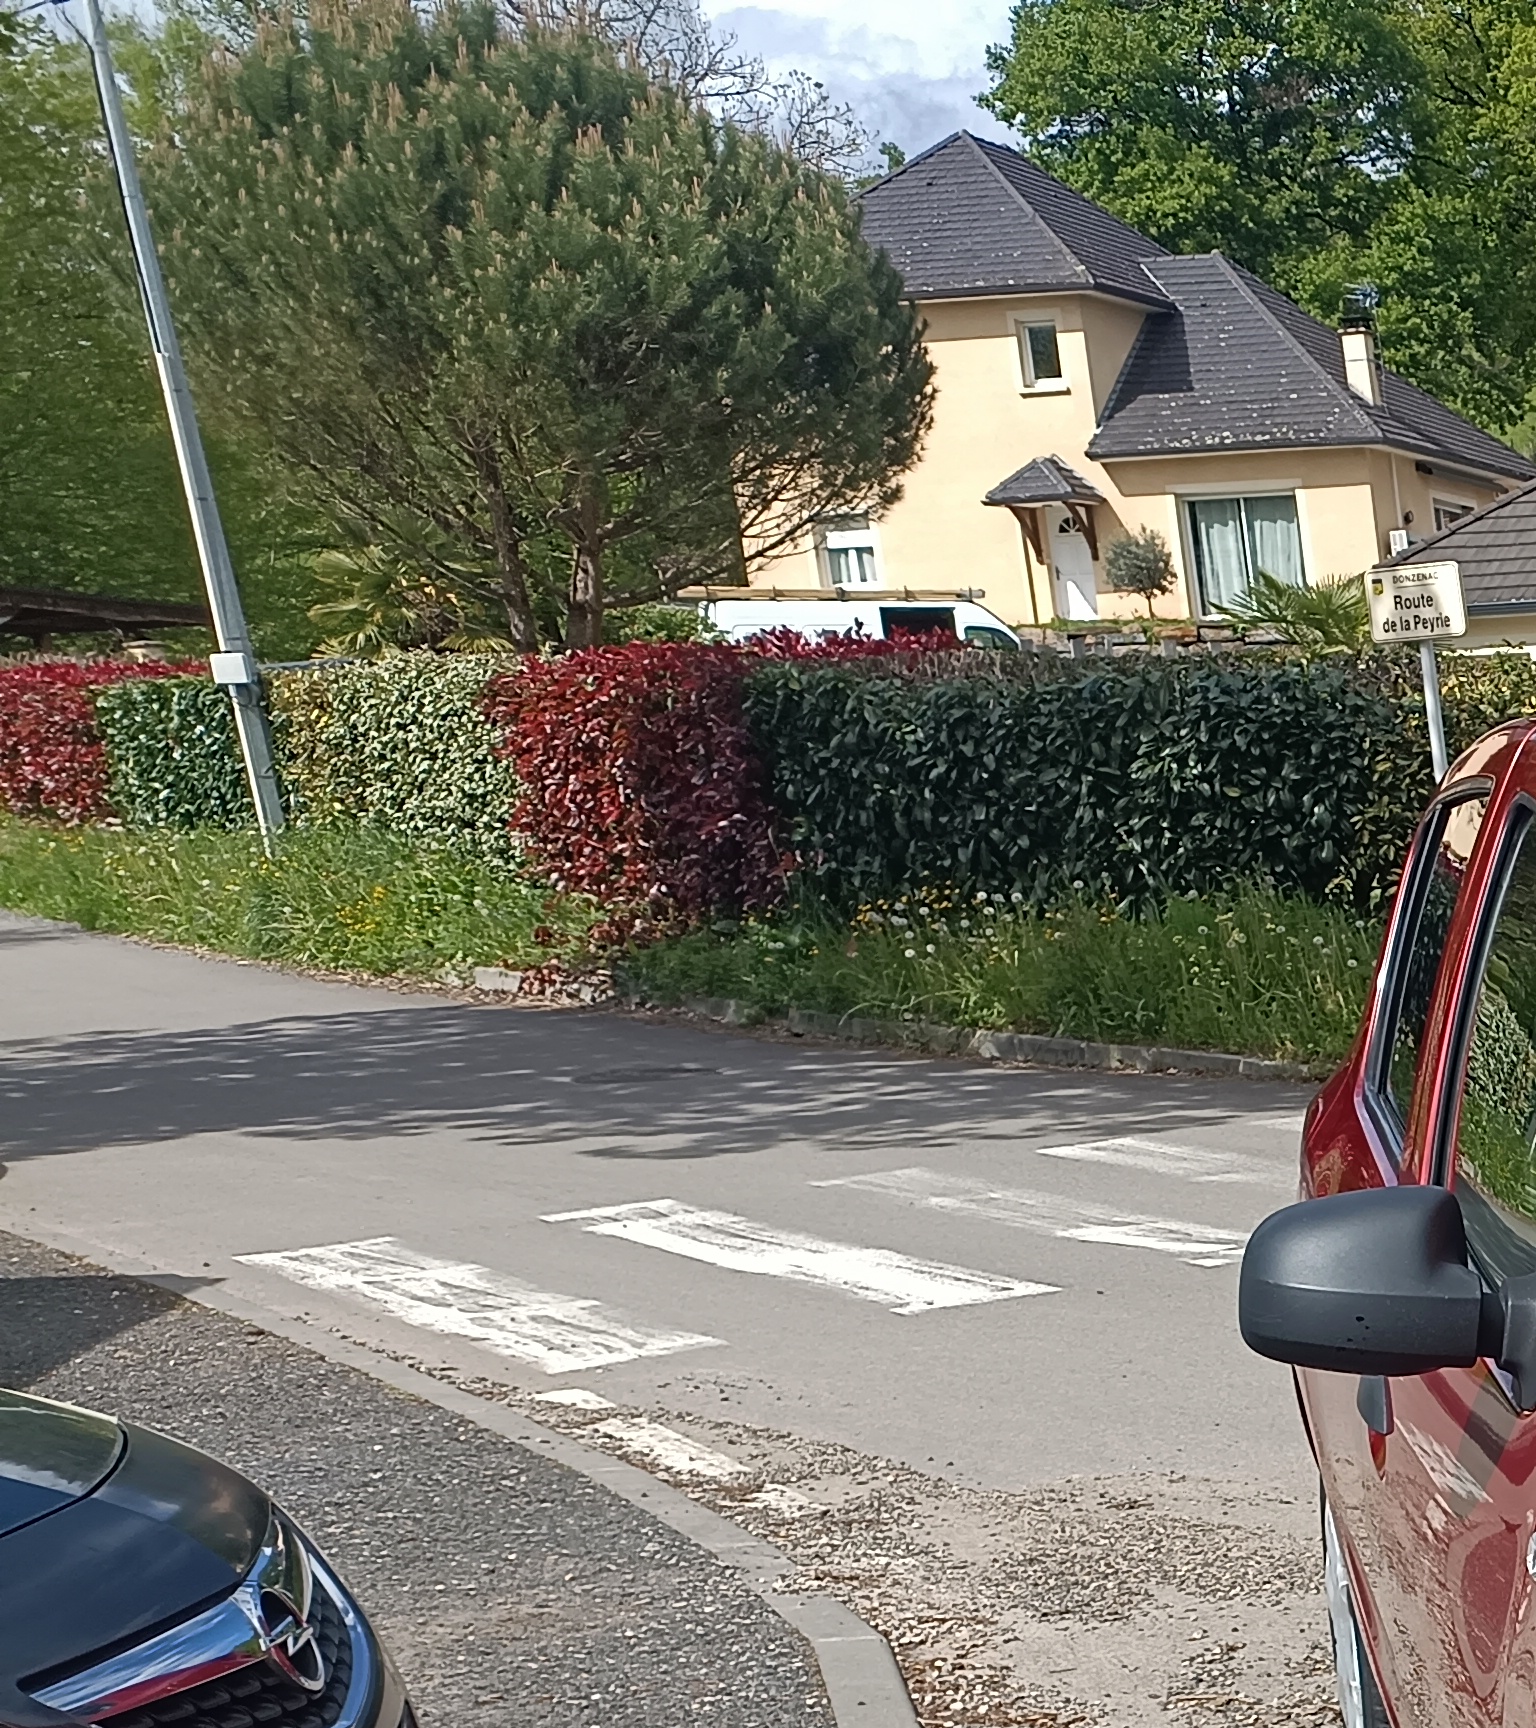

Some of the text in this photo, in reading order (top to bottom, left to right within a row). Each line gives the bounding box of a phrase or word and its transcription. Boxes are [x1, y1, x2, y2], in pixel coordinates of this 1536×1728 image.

[1392, 572, 1439, 584] DONZENAC
[1393, 593, 1434, 611] Route
[1382, 612, 1451, 633] de la Peyrie
